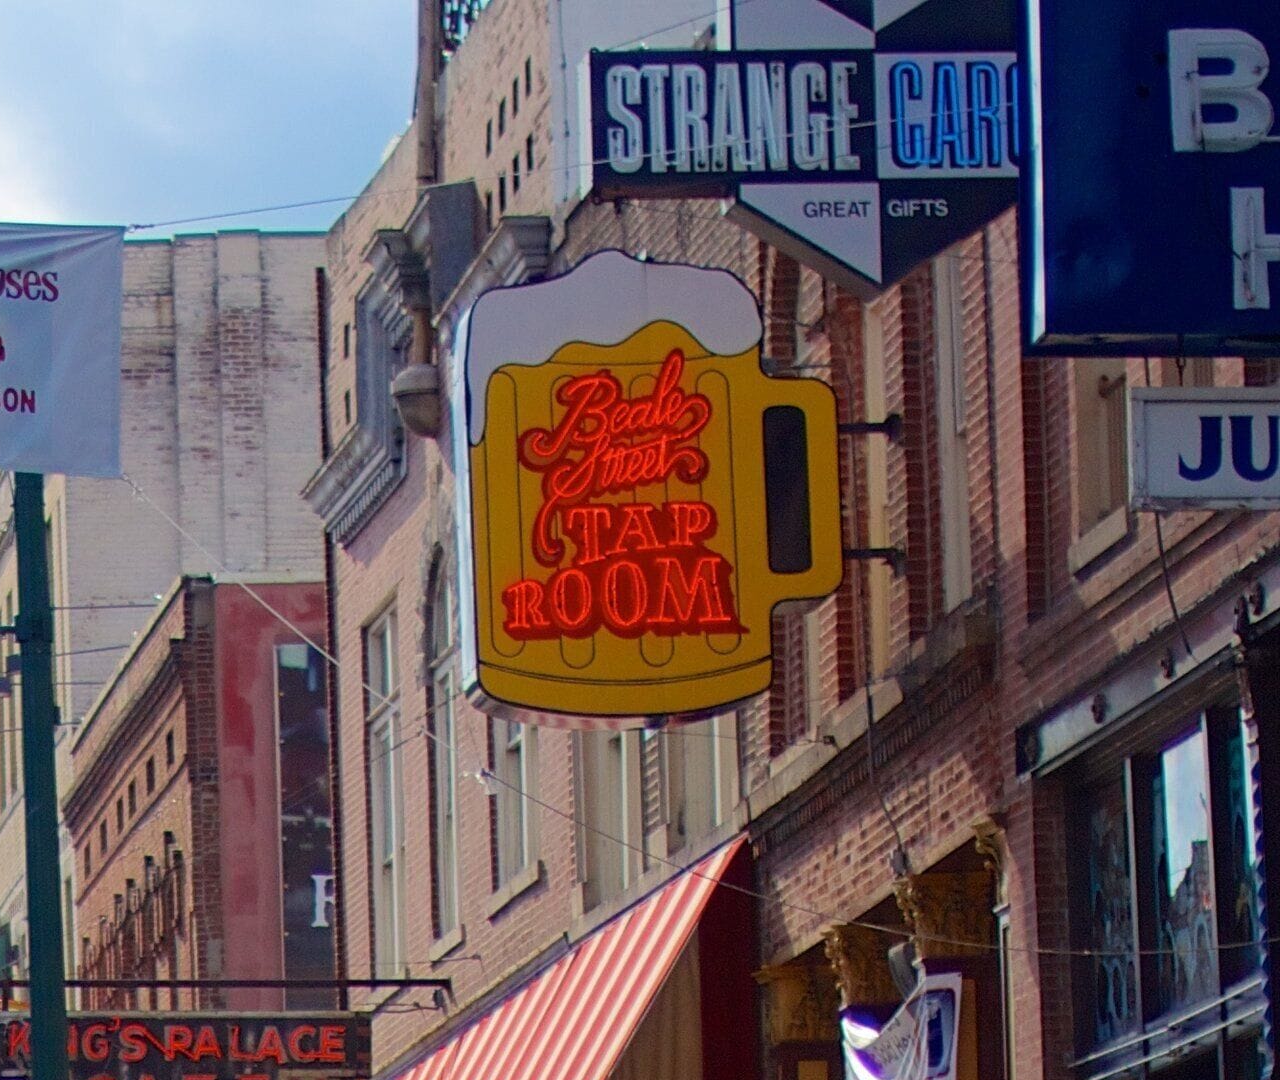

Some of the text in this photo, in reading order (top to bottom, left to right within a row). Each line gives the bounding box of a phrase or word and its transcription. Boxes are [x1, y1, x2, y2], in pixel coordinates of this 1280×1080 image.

[605, 60, 860, 172] STRANGE
[803, 199, 949, 220] GREAT GIFTS
[521, 350, 711, 466] Beale
[540, 430, 705, 545] Street
[565, 501, 714, 568] TAP
[503, 557, 734, 635] ROOM
[8, 1015, 347, 1064] KG'S PALACE
